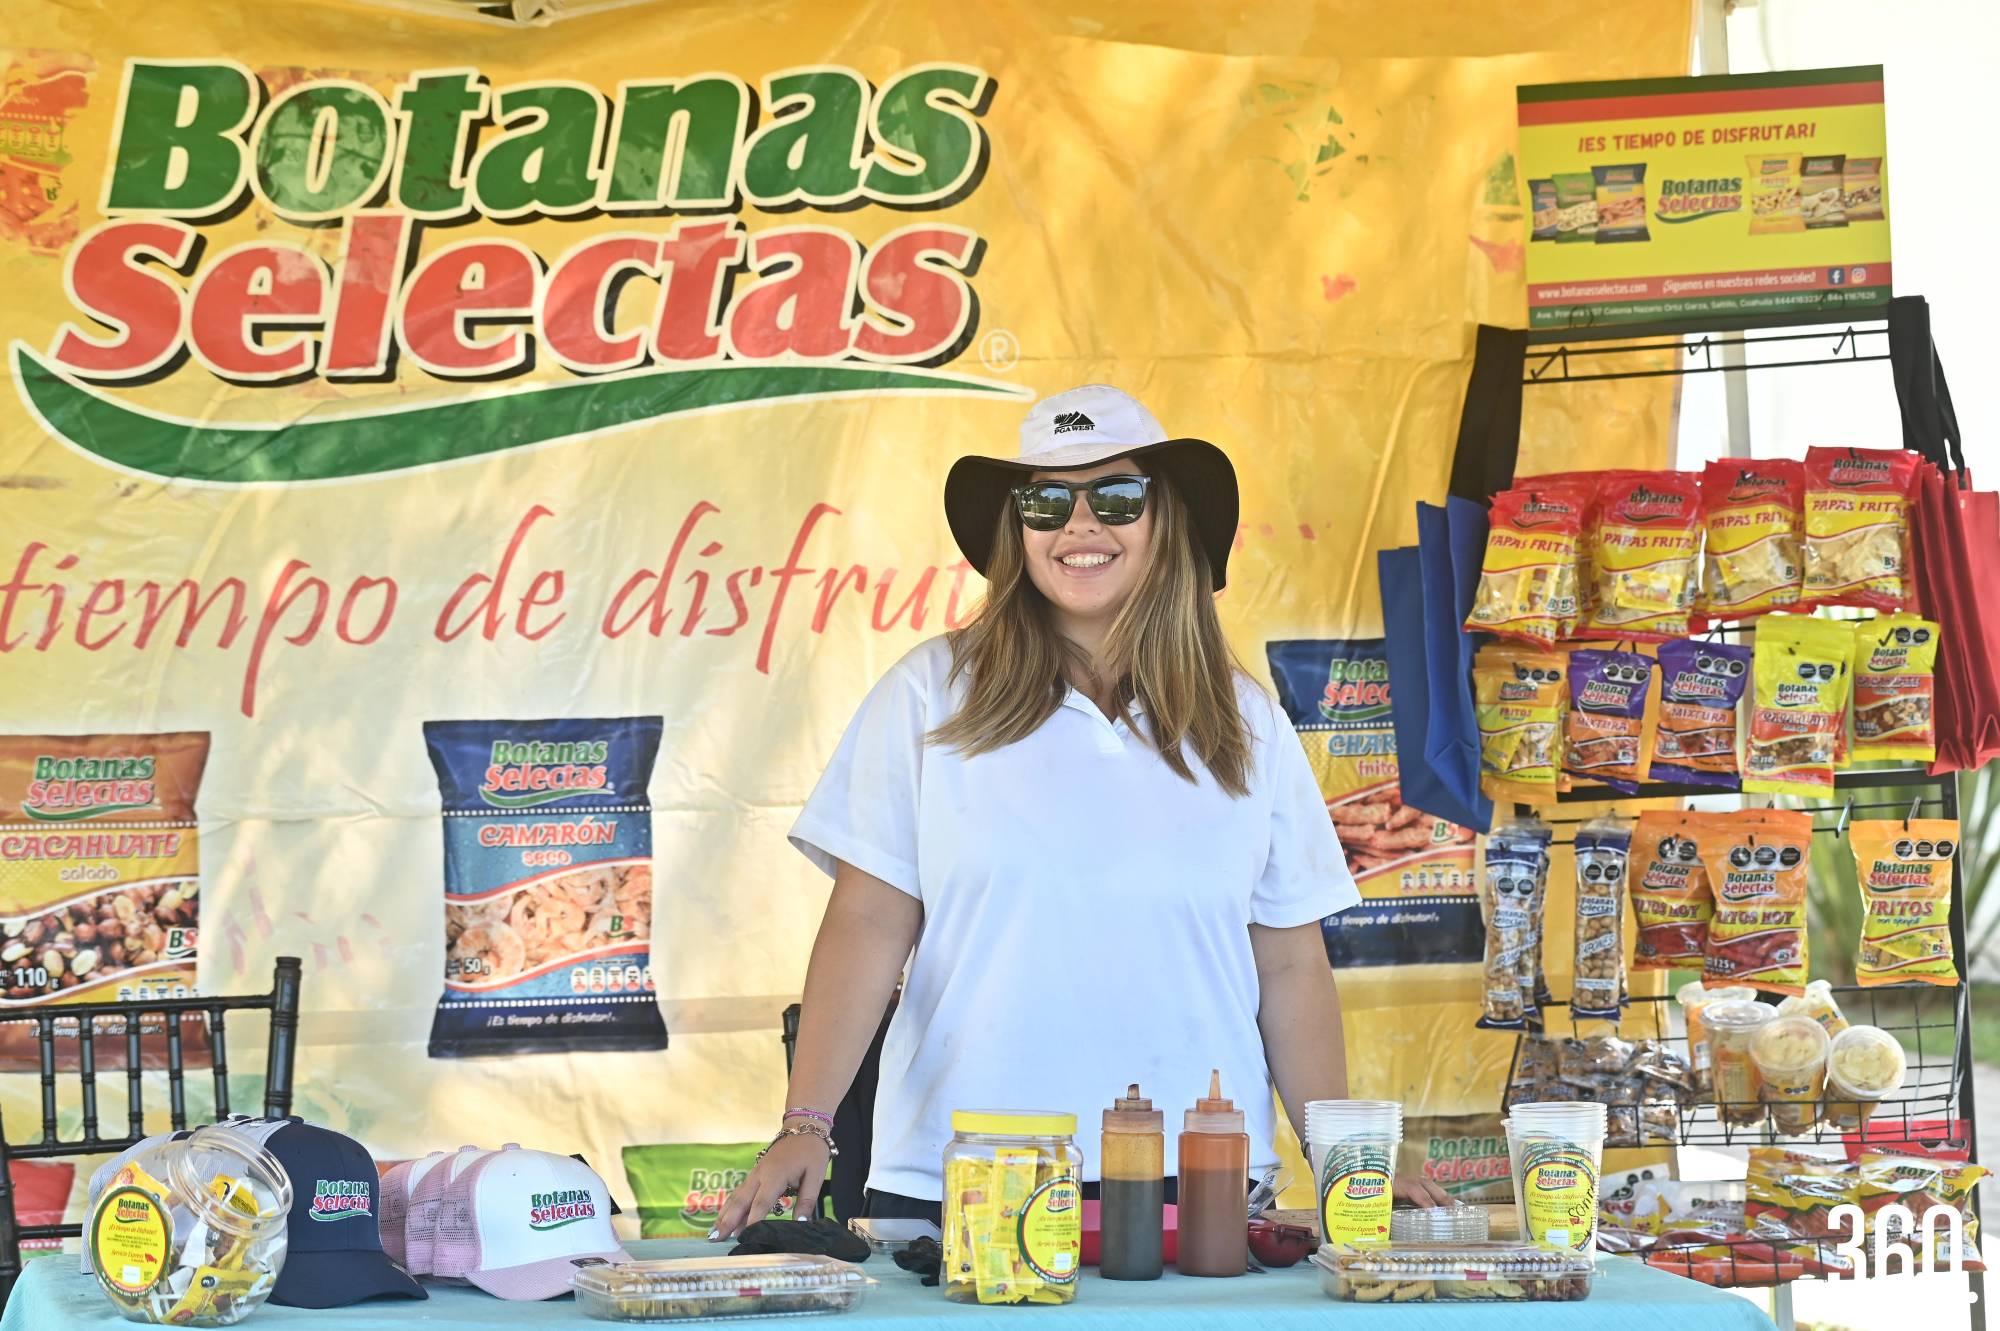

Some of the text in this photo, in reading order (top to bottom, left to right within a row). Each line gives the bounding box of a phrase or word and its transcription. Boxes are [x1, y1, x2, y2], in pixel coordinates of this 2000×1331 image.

[98, 58, 996, 222] Botanas
[1613, 130, 1676, 151] TIEMPO
[1683, 129, 1705, 147] DE
[1712, 122, 1816, 144] DISFRUTAR!
[1661, 176, 1743, 196] Botanas
[1658, 193, 1743, 214] Selectas
[50, 211, 987, 382] Selectas
[1812, 500, 1856, 512] PAPAS
[1712, 516, 1751, 530] PAPAS
[1603, 533, 1648, 548] PAPAS
[0, 538, 400, 716] tiempo
[434, 503, 567, 642] de
[1329, 658, 1389, 682] Bota
[1678, 672, 1726, 687] Botanas
[1323, 678, 1392, 707] Selec
[493, 740, 608, 766] Botanas
[35, 756, 156, 781] Botanas
[484, 764, 608, 792] Selectas
[27, 780, 156, 808] Selectas
[479, 817, 617, 847] CAMARÓN
[1, 832, 180, 860] CACAHUATE
[522, 850, 572, 867] seco
[1873, 860, 1933, 874] Botanas
[60, 864, 119, 883] salado
[1727, 872, 1775, 883] Botanas
[1870, 872, 1931, 886] Selectas
[1724, 881, 1775, 894] Selectas
[1760, 911, 1796, 925] HOT
[14, 967, 48, 987] 110
[507, 1014, 543, 1029] tiempo
[546, 1013, 559, 1025] de
[1426, 1135, 1509, 1160] Botana
[1423, 1156, 1511, 1182] Selecta
[1538, 1168, 1577, 1178] Botanas
[315, 1179, 370, 1198] Botanas
[1348, 1177, 1386, 1187] Botanas
[313, 1194, 371, 1213] Selectas
[530, 1190, 592, 1211] Botanas
[530, 1203, 595, 1225] Selectas
